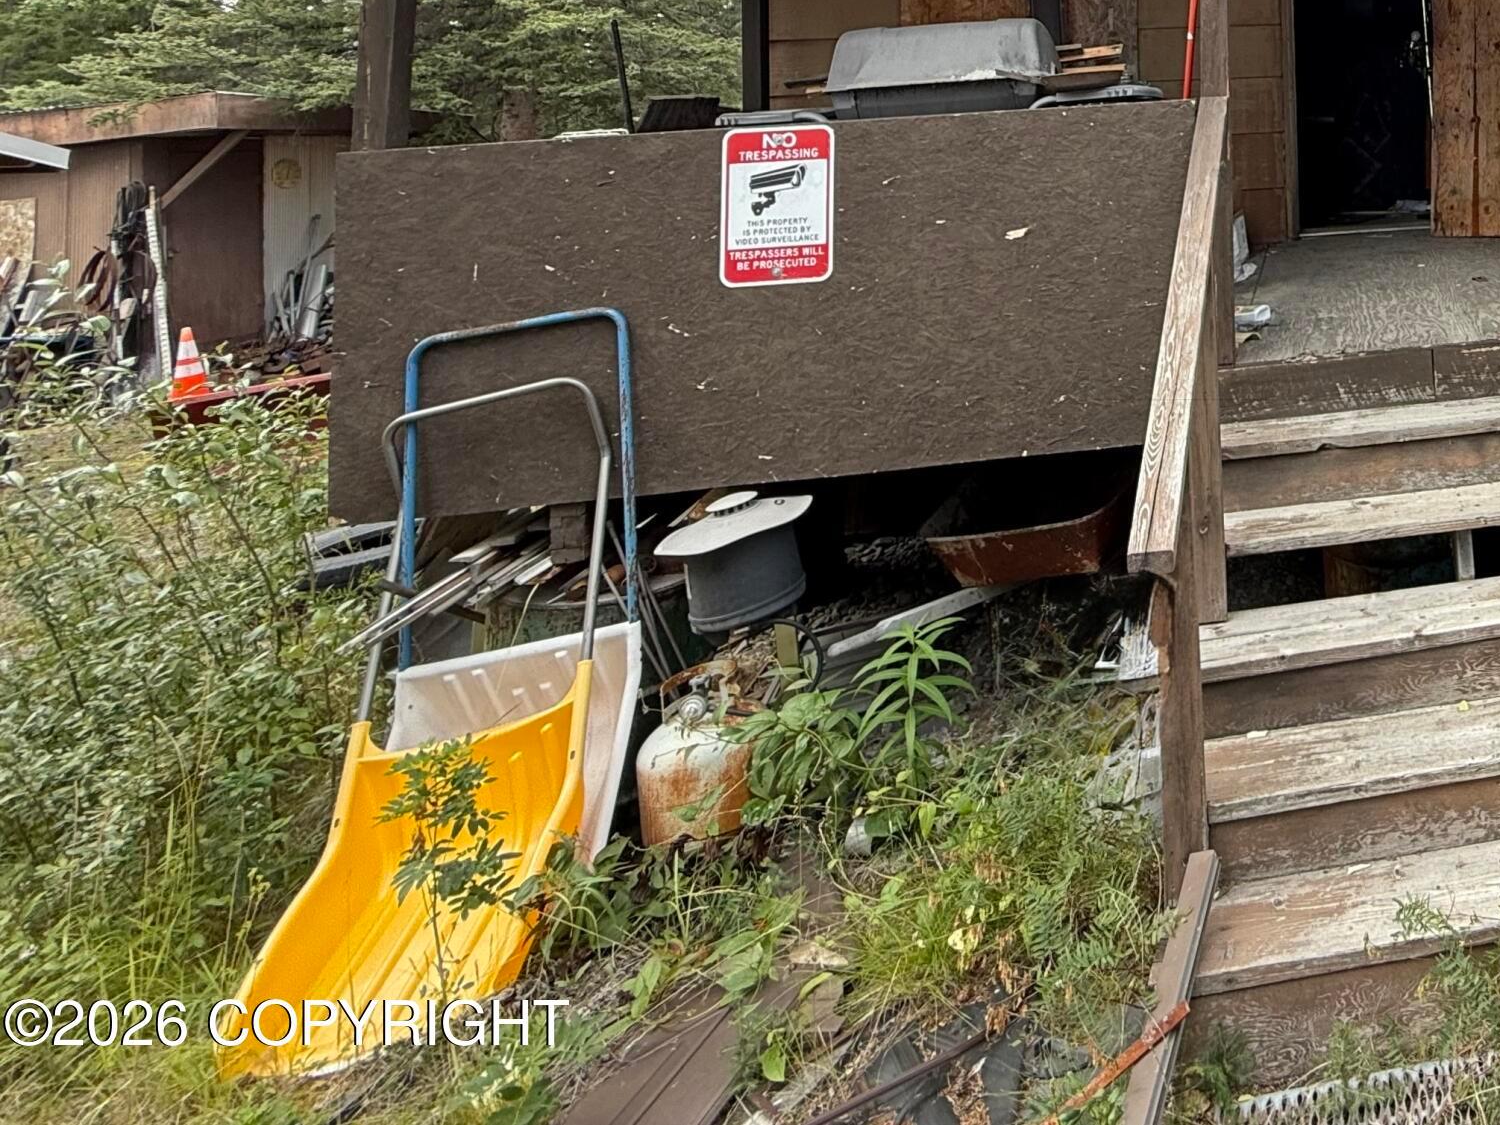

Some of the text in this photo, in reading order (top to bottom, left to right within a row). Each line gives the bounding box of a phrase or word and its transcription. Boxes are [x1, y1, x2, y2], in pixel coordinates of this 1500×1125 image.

[762, 132, 797, 149] NO
[738, 147, 819, 162] TRESPASSING
[747, 217, 808, 227] THIS PROPERTY
[753, 226, 798, 235] PROTECTED
[735, 234, 819, 246] VIDEO SURVEILLANCE
[729, 246, 825, 261] TRESPASSERS WILL
[736, 257, 817, 271] BE PROSECUTED
